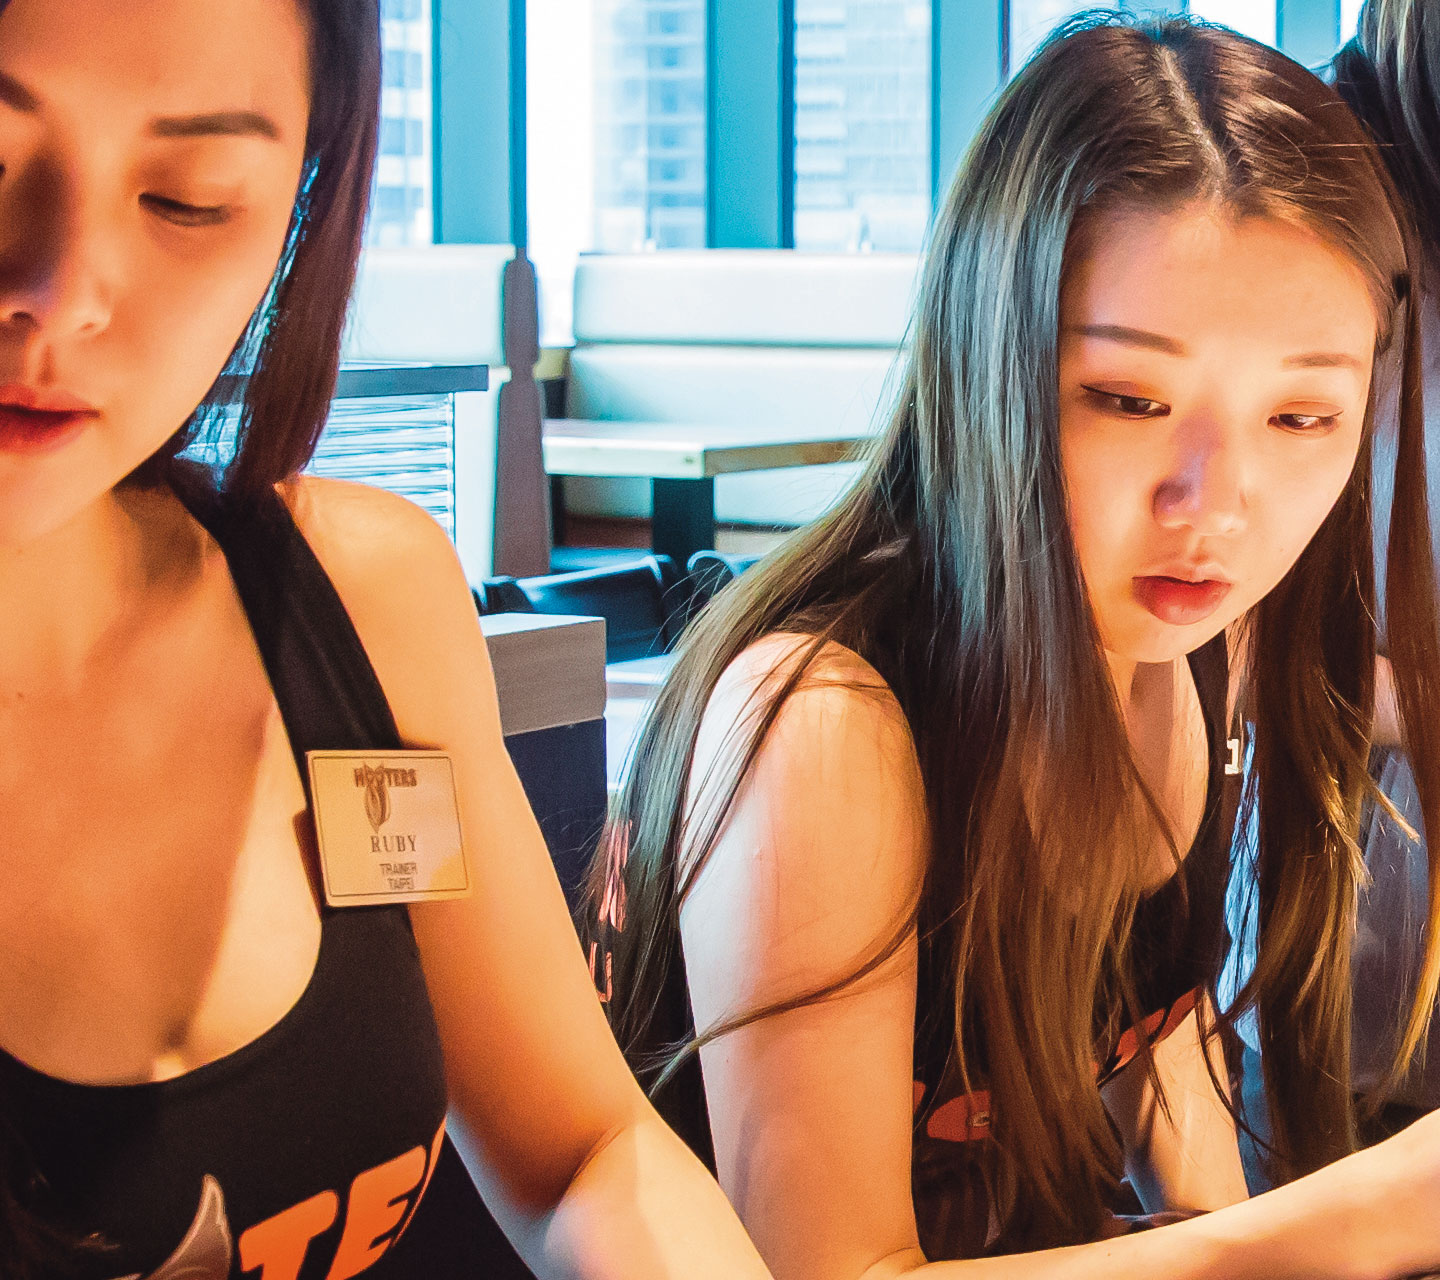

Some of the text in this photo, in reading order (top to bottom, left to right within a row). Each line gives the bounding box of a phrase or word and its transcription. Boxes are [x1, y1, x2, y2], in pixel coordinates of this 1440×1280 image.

[354, 767, 418, 788] HOOTERS
[370, 834, 418, 854] RUBY
[379, 862, 419, 876] TRAINER
